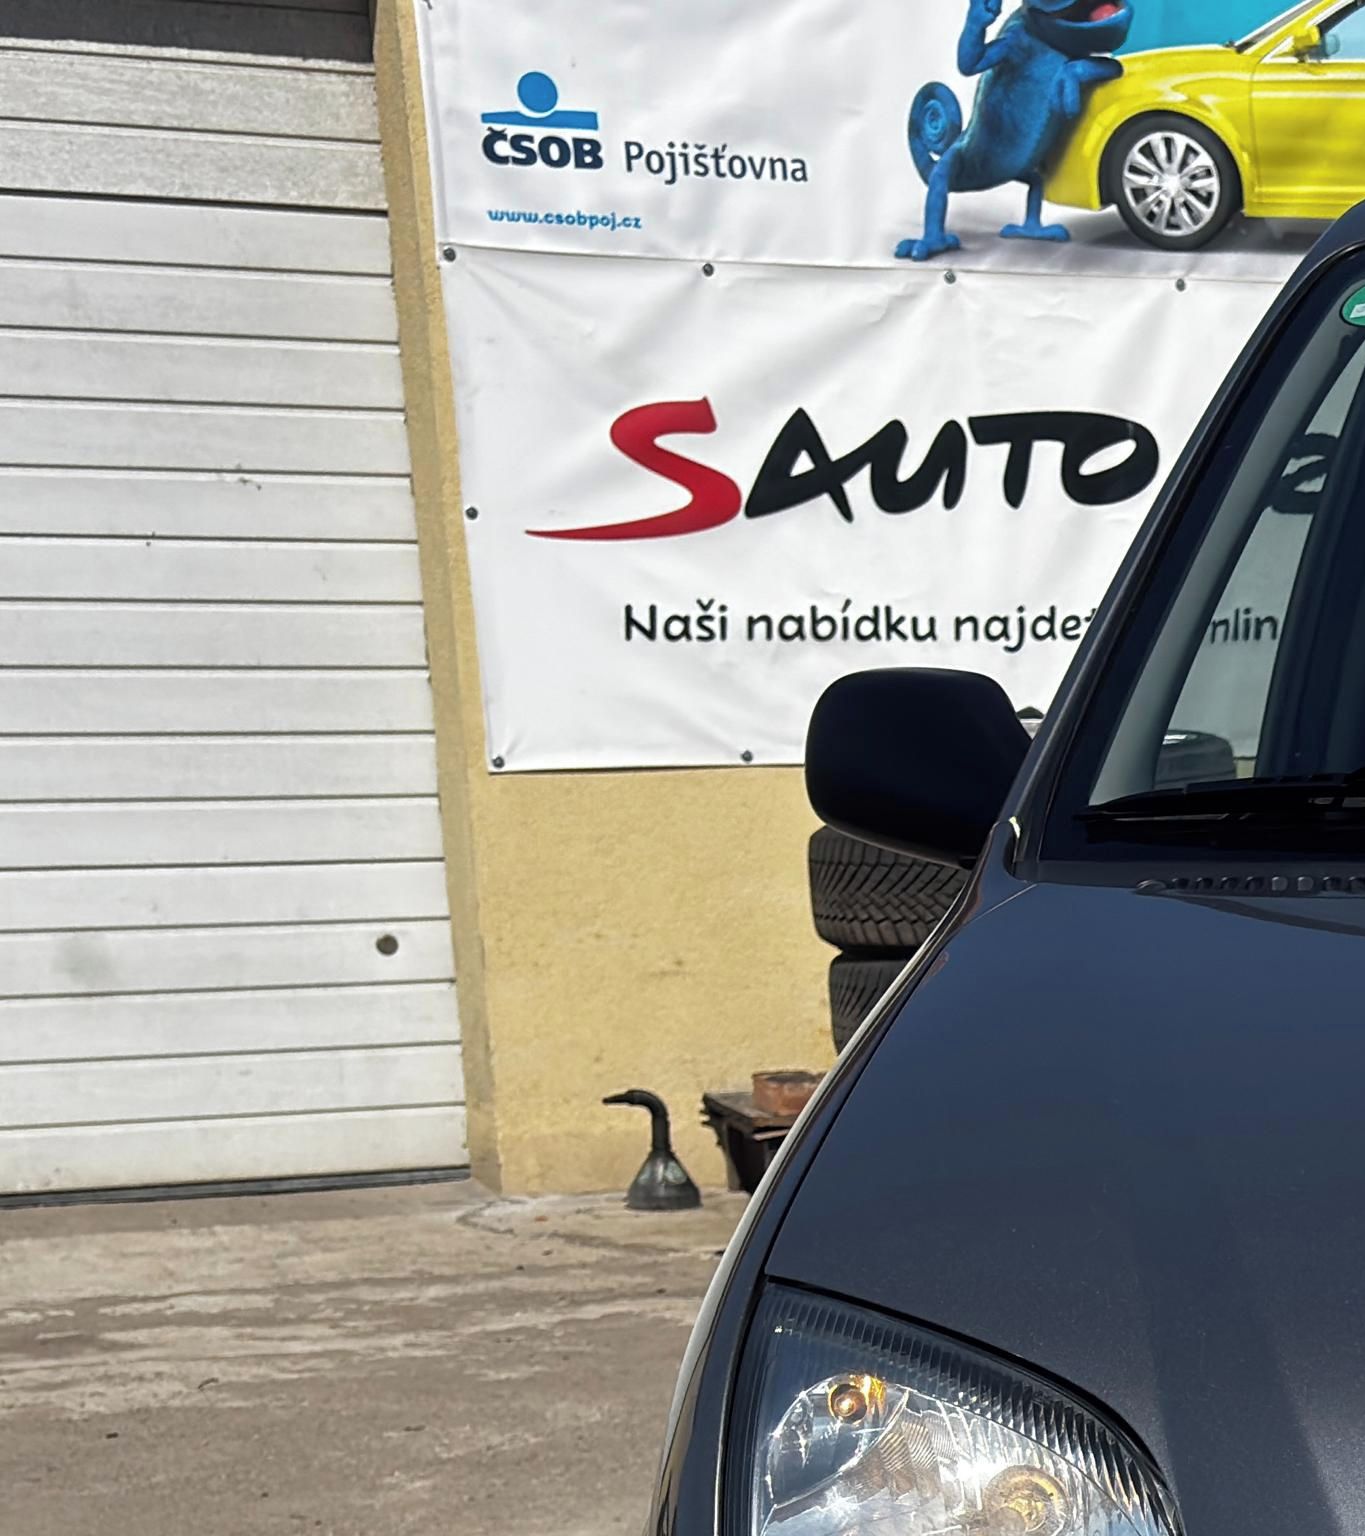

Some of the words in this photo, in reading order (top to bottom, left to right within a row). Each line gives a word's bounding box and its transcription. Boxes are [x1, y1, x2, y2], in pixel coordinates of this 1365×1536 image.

[482, 127, 605, 171] ČSOB
[625, 141, 809, 185] Pojišťovna
[488, 209, 643, 231] www.csobpoj.cz
[624, 600, 728, 643] Naši
[747, 599, 938, 643] nabídku
